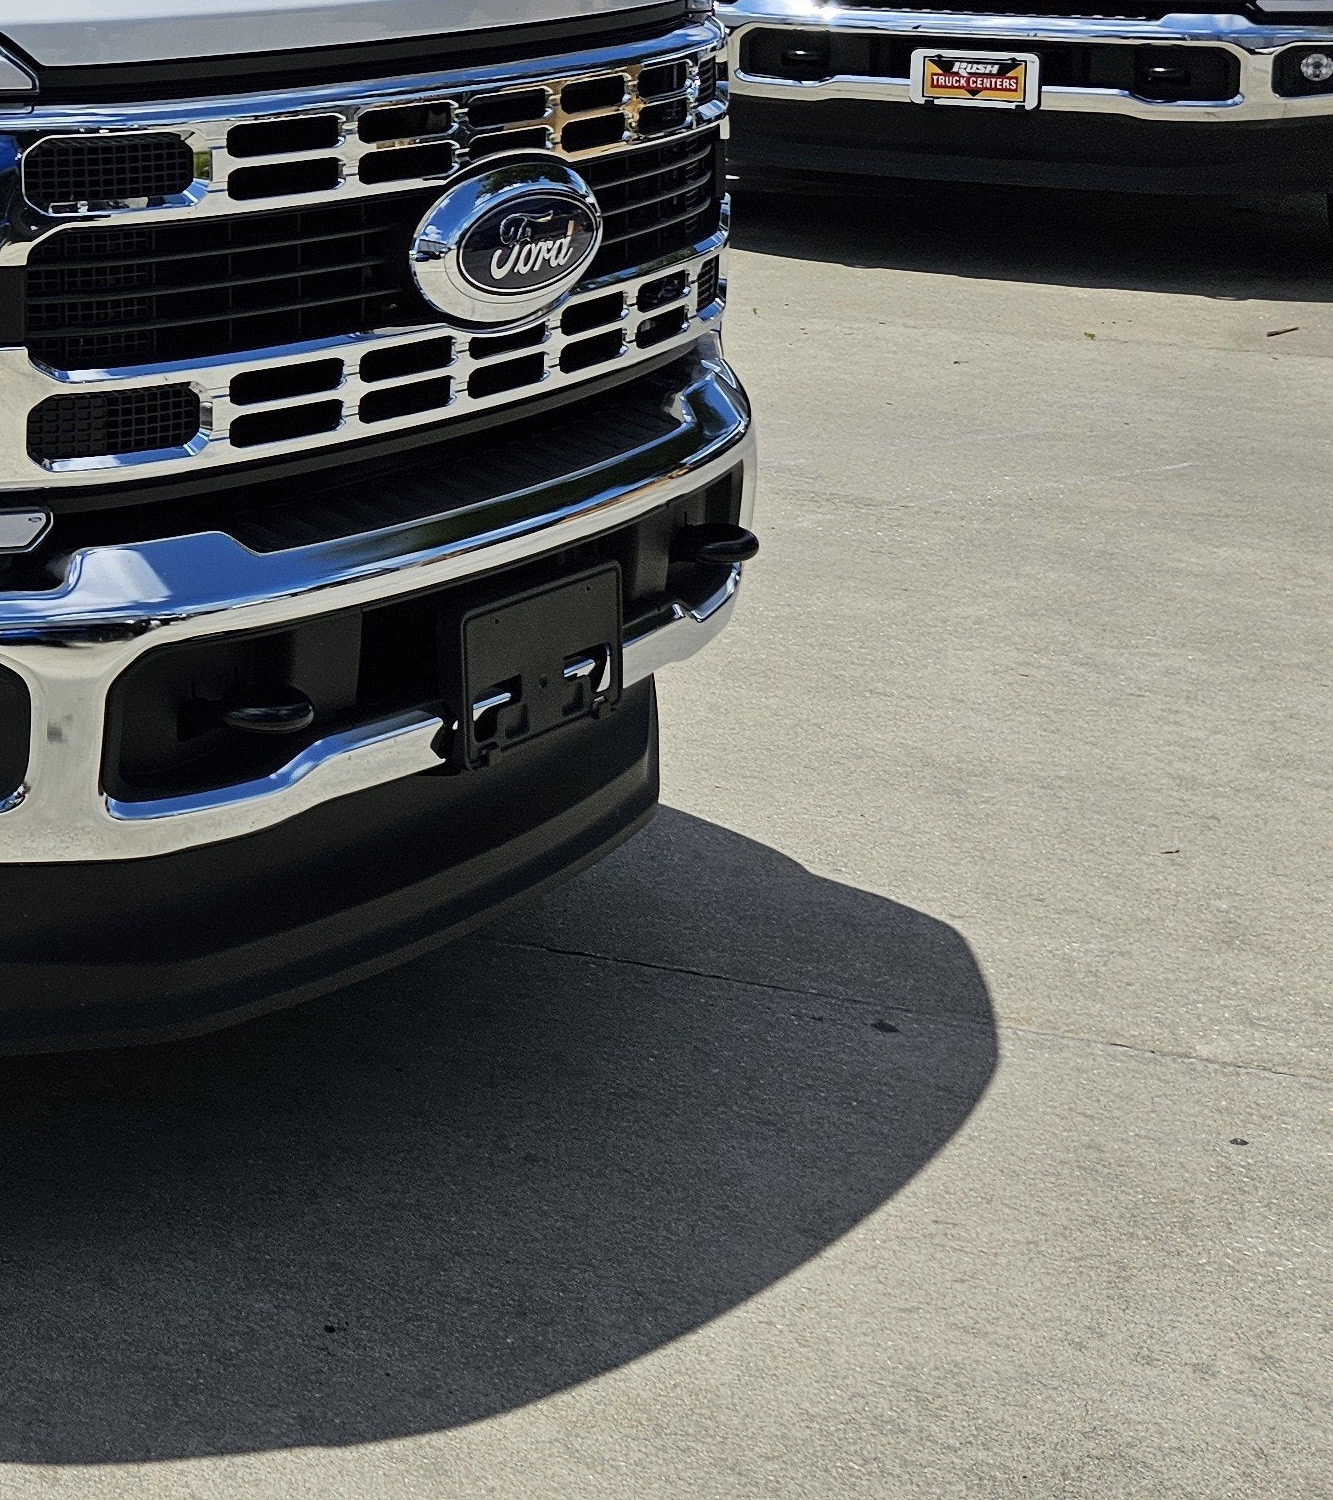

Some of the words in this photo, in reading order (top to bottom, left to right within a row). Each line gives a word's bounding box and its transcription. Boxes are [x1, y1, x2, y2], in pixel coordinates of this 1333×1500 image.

[949, 61, 1001, 77] RUSH
[932, 75, 967, 88] TRUCK
[969, 76, 1018, 90] CENTERS
[489, 209, 575, 281] Ford
